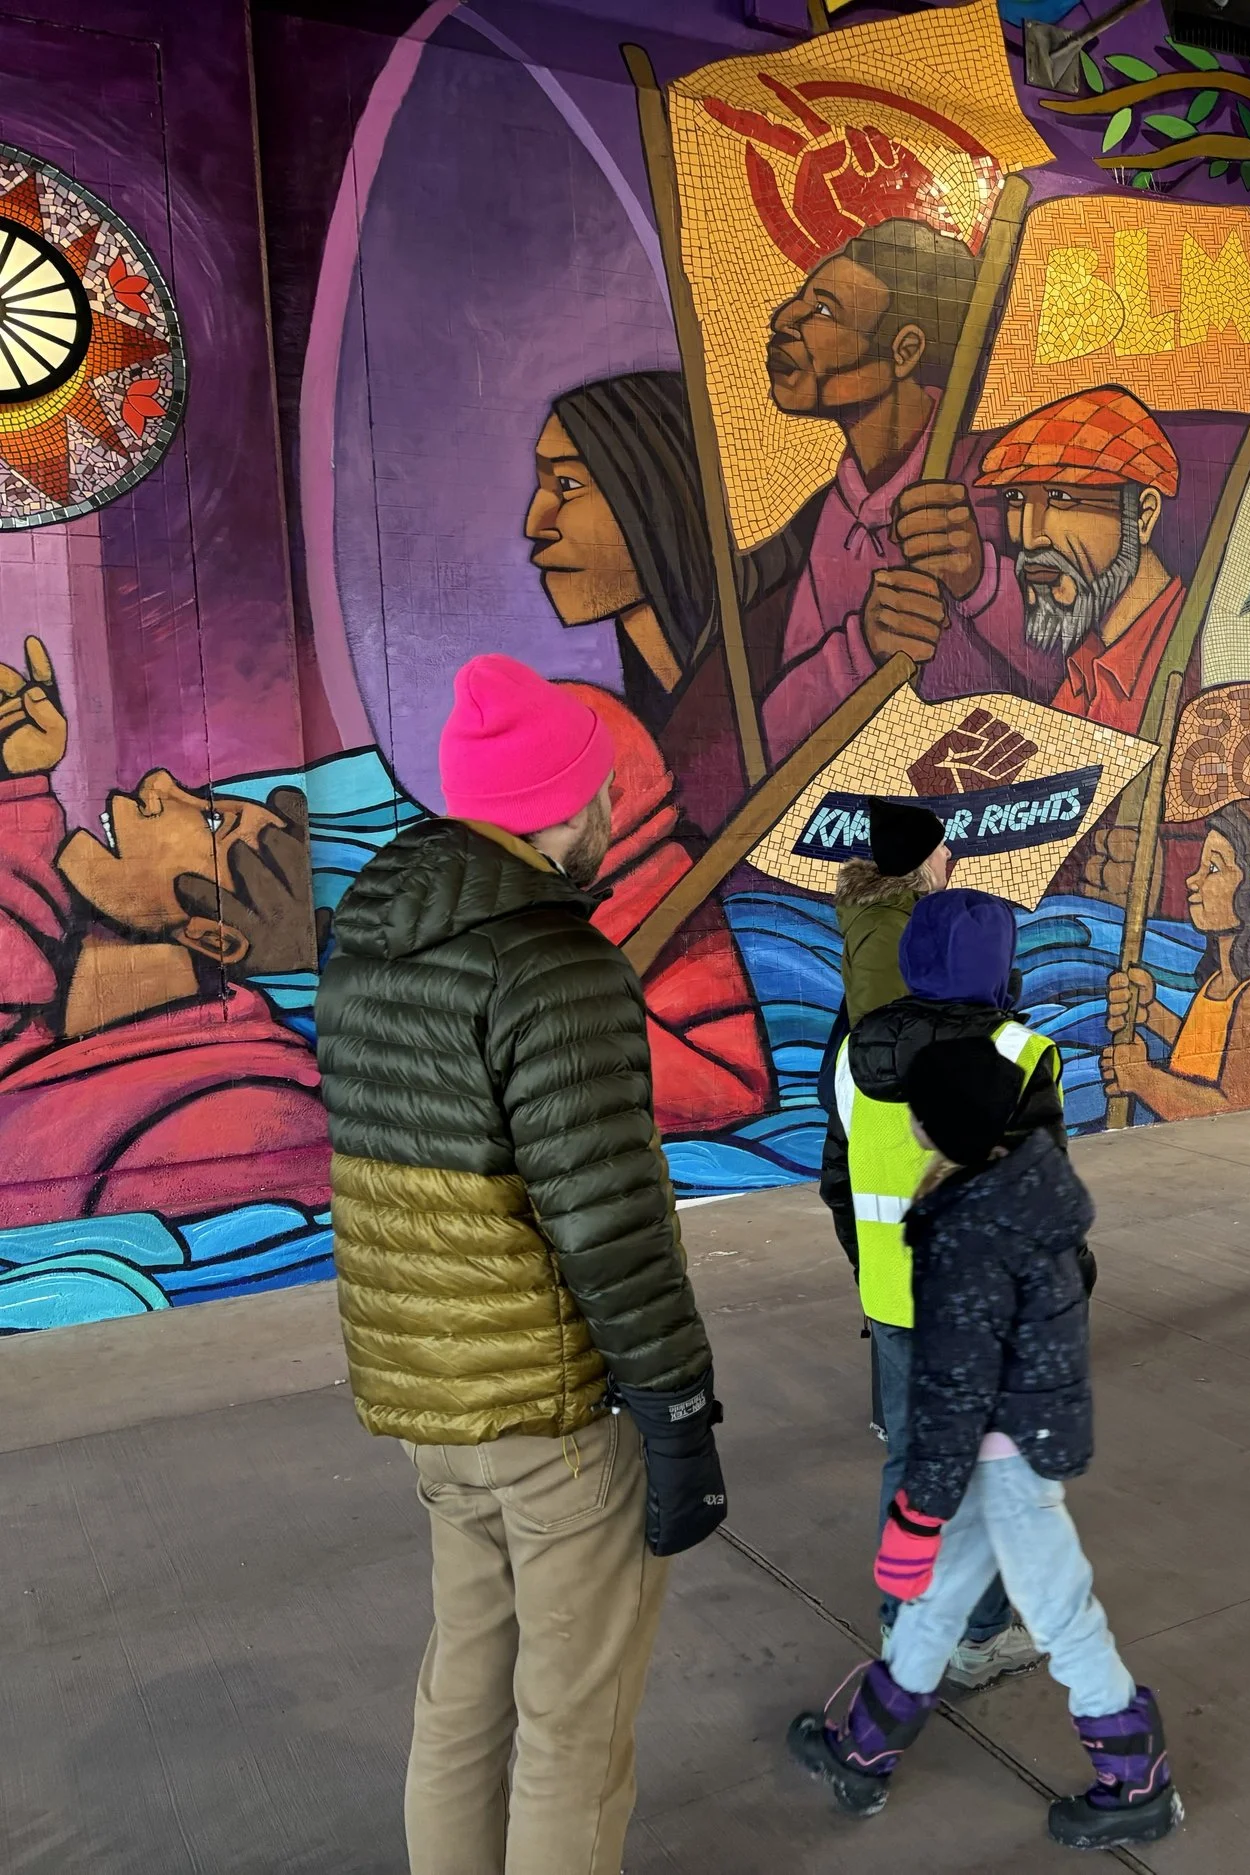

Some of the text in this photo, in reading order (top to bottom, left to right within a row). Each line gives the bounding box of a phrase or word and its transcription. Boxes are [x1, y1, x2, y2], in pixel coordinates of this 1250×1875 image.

[803, 788, 1081, 848] KNO UR RIGHTS
